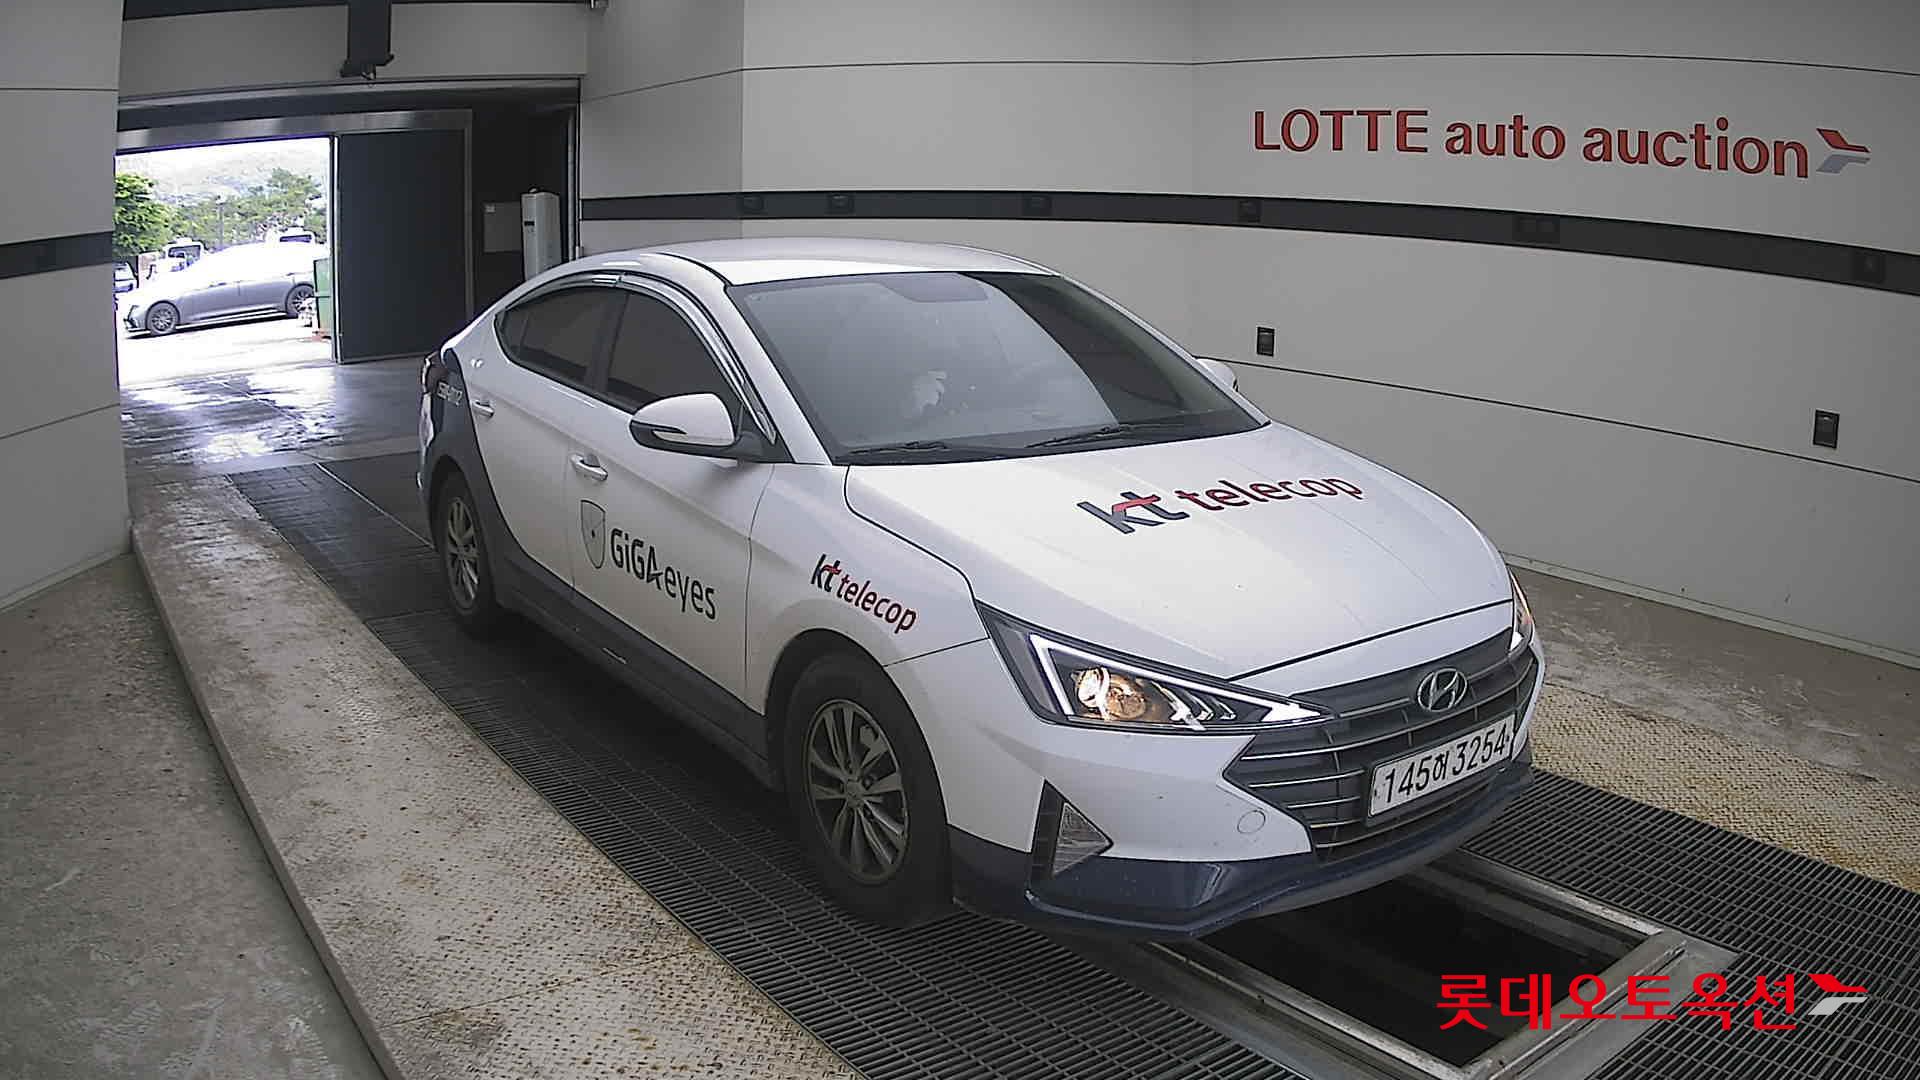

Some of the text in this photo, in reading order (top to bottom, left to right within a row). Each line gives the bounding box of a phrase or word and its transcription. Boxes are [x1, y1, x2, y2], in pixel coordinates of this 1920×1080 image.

[1253, 109, 1809, 179] LOTTE auto auction
[1077, 477, 1363, 534] kt telecop
[811, 553, 917, 634] kt telecop
